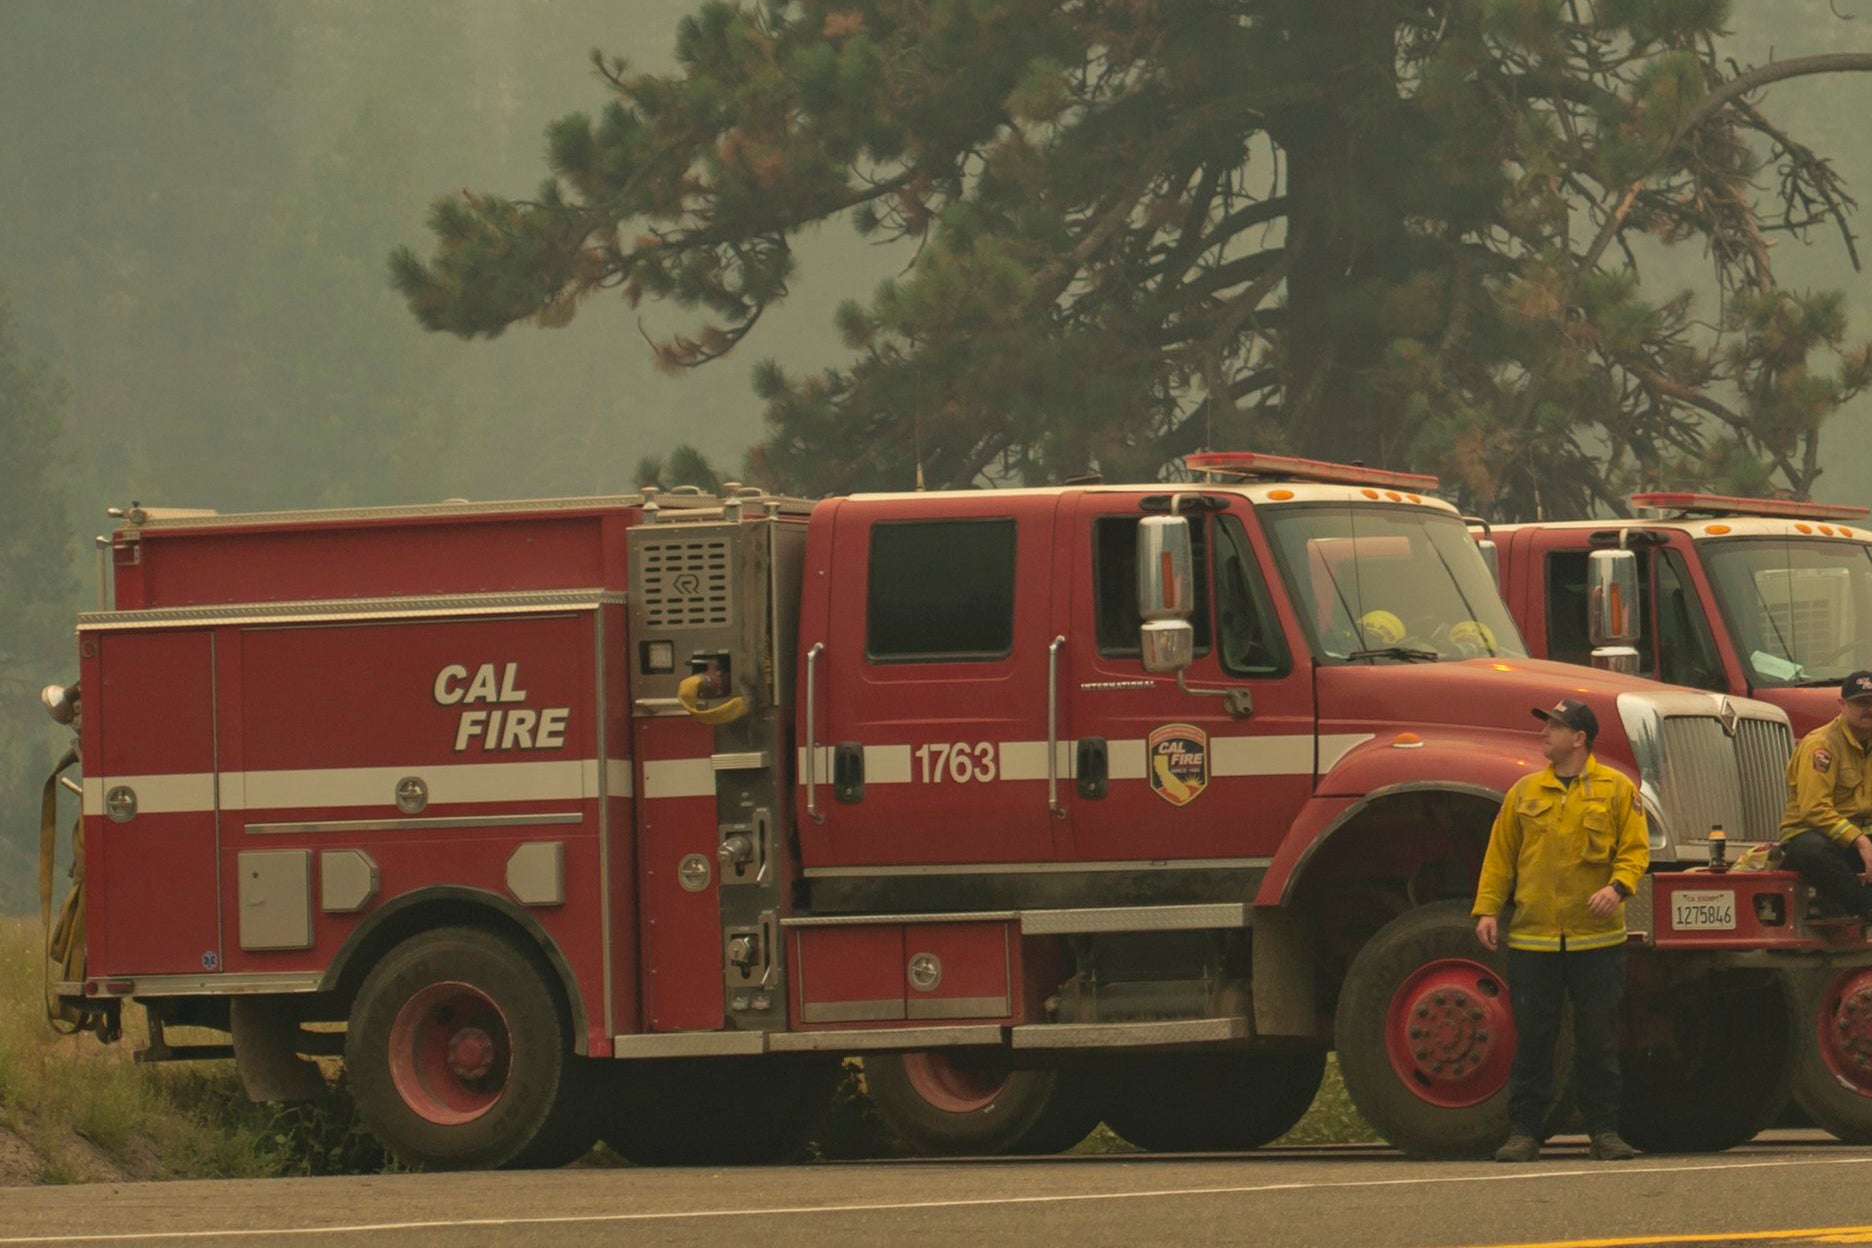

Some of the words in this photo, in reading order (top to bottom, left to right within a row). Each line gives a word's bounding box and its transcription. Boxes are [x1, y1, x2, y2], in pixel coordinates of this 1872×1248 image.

[433, 662, 527, 705] CAL
[454, 708, 570, 751] FIRE
[915, 741, 996, 784] 1763
[1158, 741, 1186, 753] CAL
[1171, 753, 1203, 765] FIRE
[1676, 905, 1732, 925] 1275846
